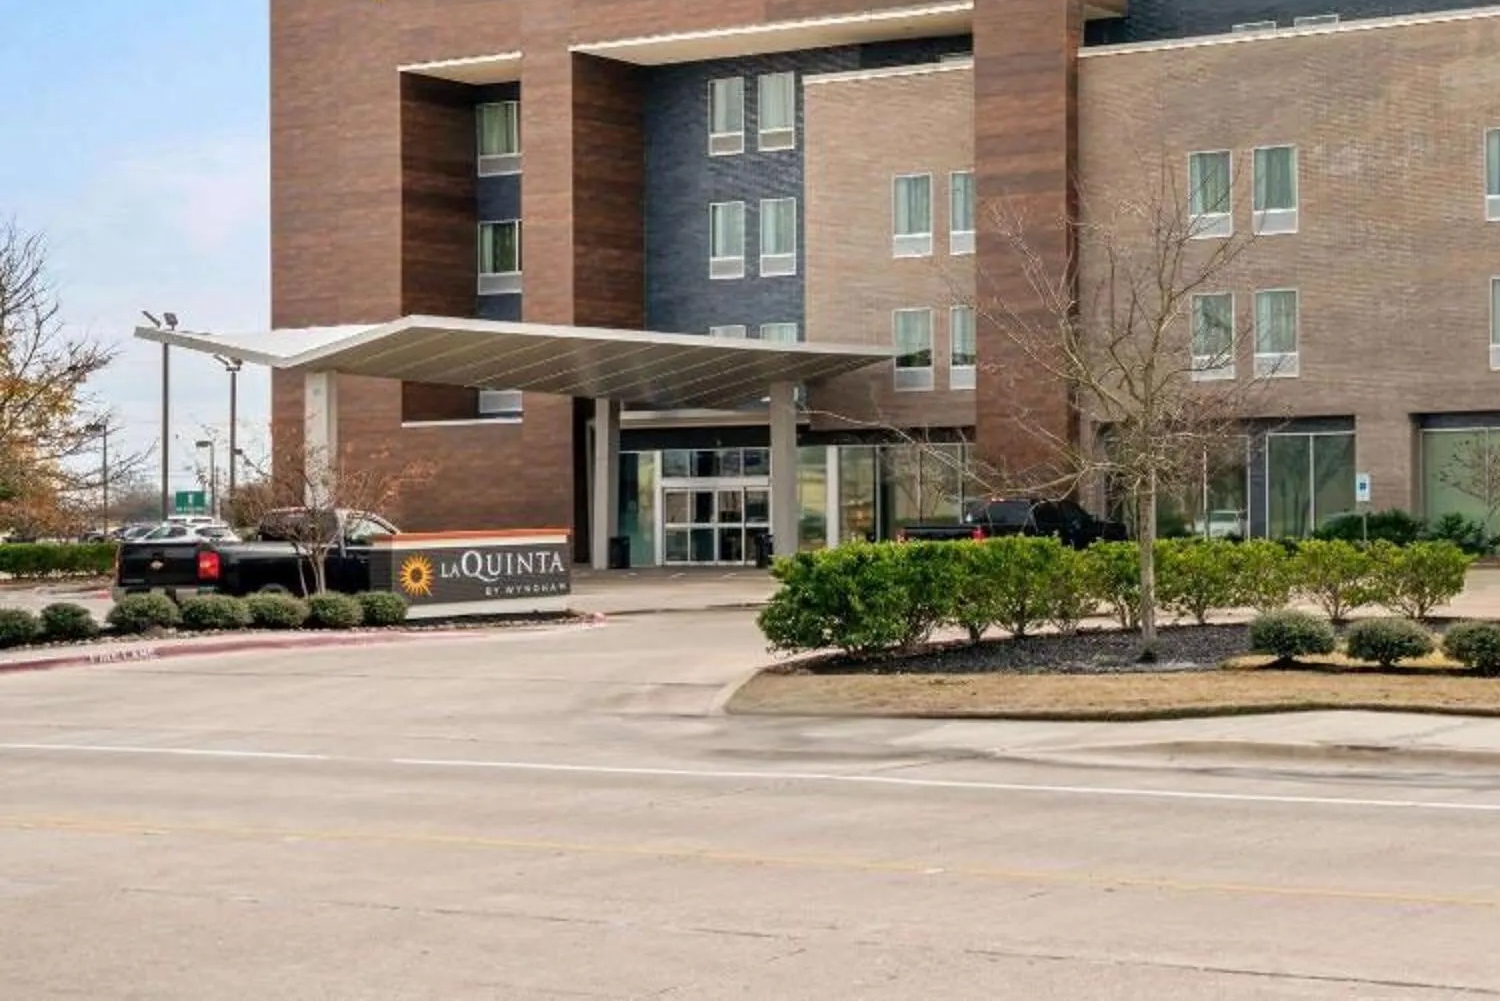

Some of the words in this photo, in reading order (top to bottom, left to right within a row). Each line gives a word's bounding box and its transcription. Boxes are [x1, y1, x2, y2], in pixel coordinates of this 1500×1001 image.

[441, 562, 461, 578] LA
[462, 550, 565, 582] QUINTA
[485, 586, 499, 596] BY
[505, 582, 567, 595] WYNDHAM
